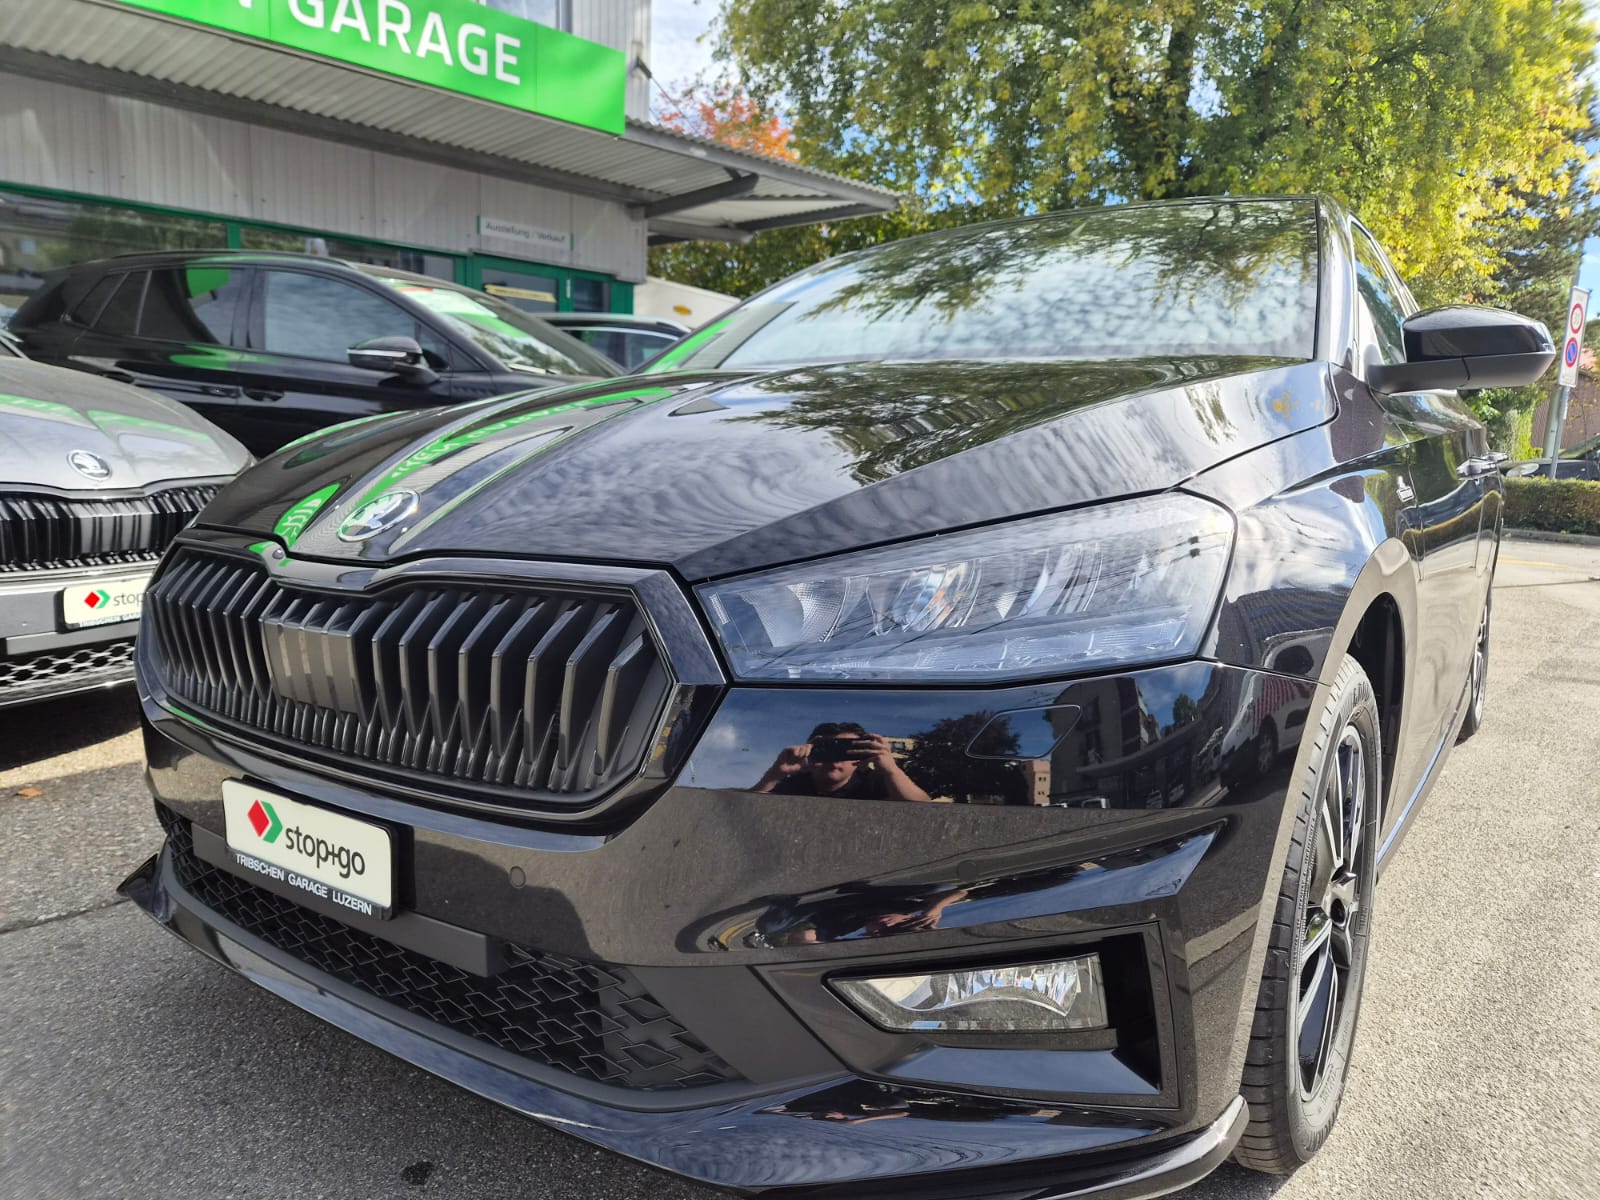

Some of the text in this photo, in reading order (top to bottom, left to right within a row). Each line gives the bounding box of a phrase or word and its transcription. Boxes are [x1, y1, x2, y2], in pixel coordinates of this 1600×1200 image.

[288, 0, 520, 85] GARAGE
[285, 826, 365, 879] stop+go
[235, 854, 372, 916] TRIBSCHEN GARAGE LUZERN
